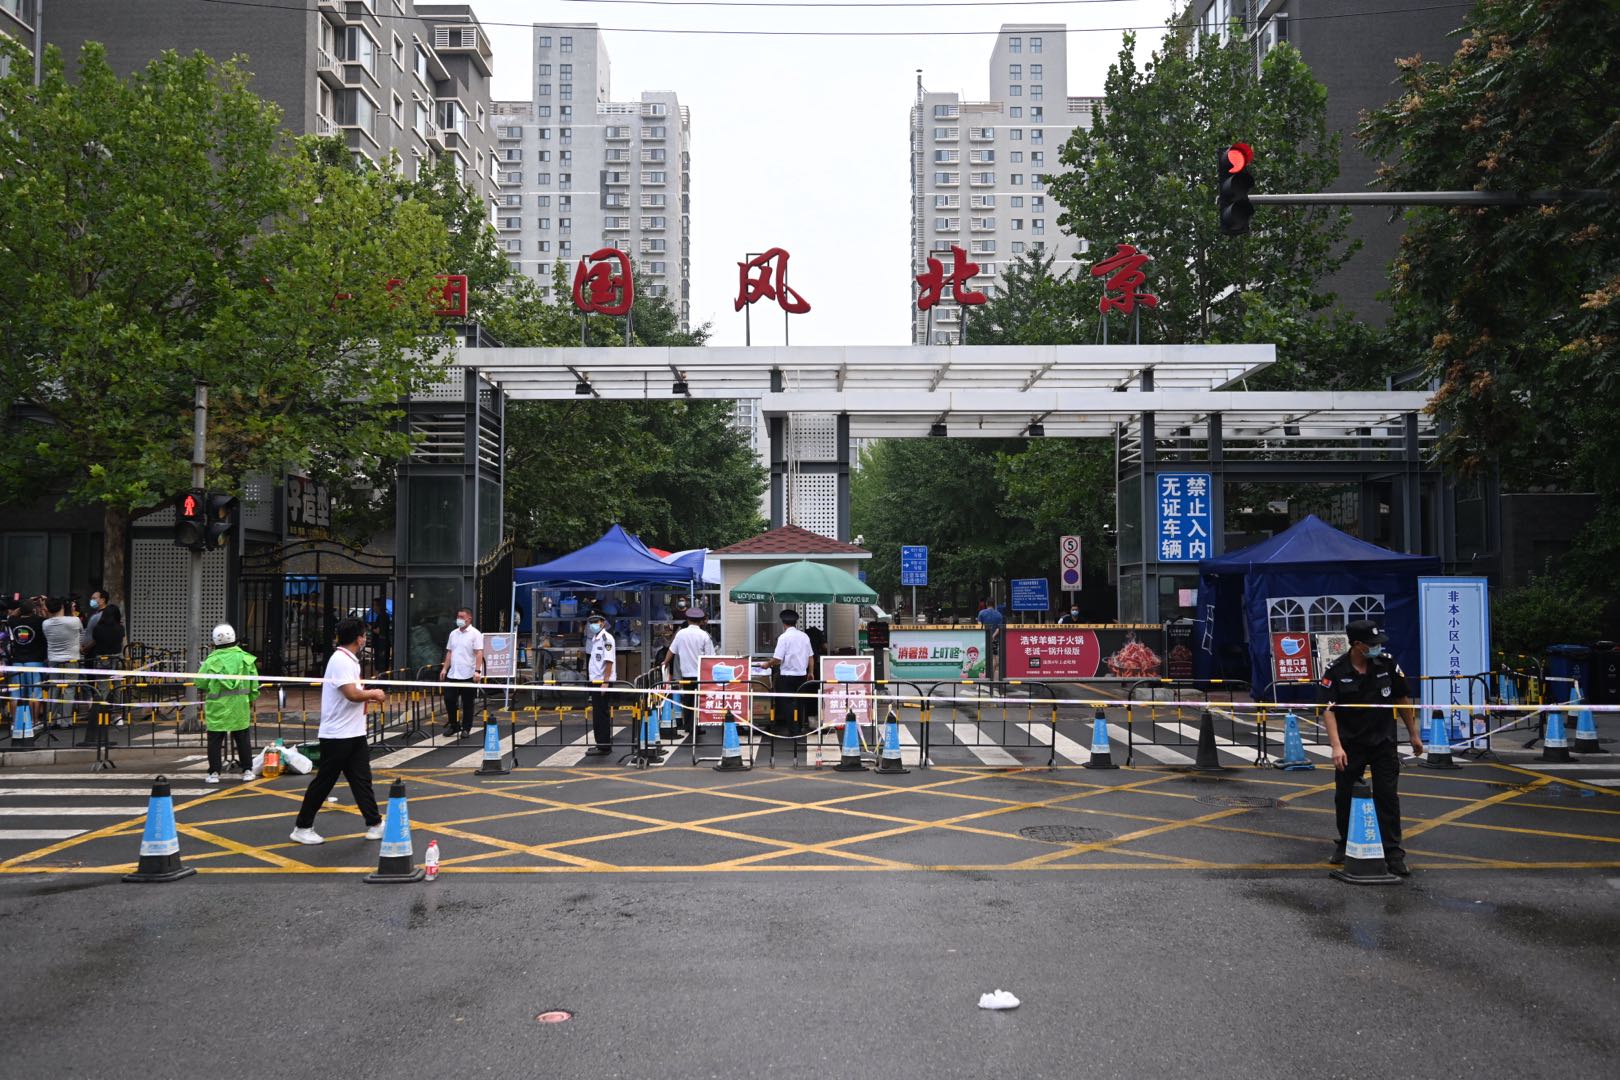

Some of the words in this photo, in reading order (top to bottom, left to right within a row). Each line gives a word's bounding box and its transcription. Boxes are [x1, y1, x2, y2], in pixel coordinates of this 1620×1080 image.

[1162, 478, 1181, 559] 无证车辆
[1187, 477, 1207, 559] 禁止入内
[1067, 540, 1074, 550] 5
[898, 646, 928, 659] 消暑热
[930, 646, 960, 659] 上叮咚
[705, 700, 742, 709] 禁止入内
